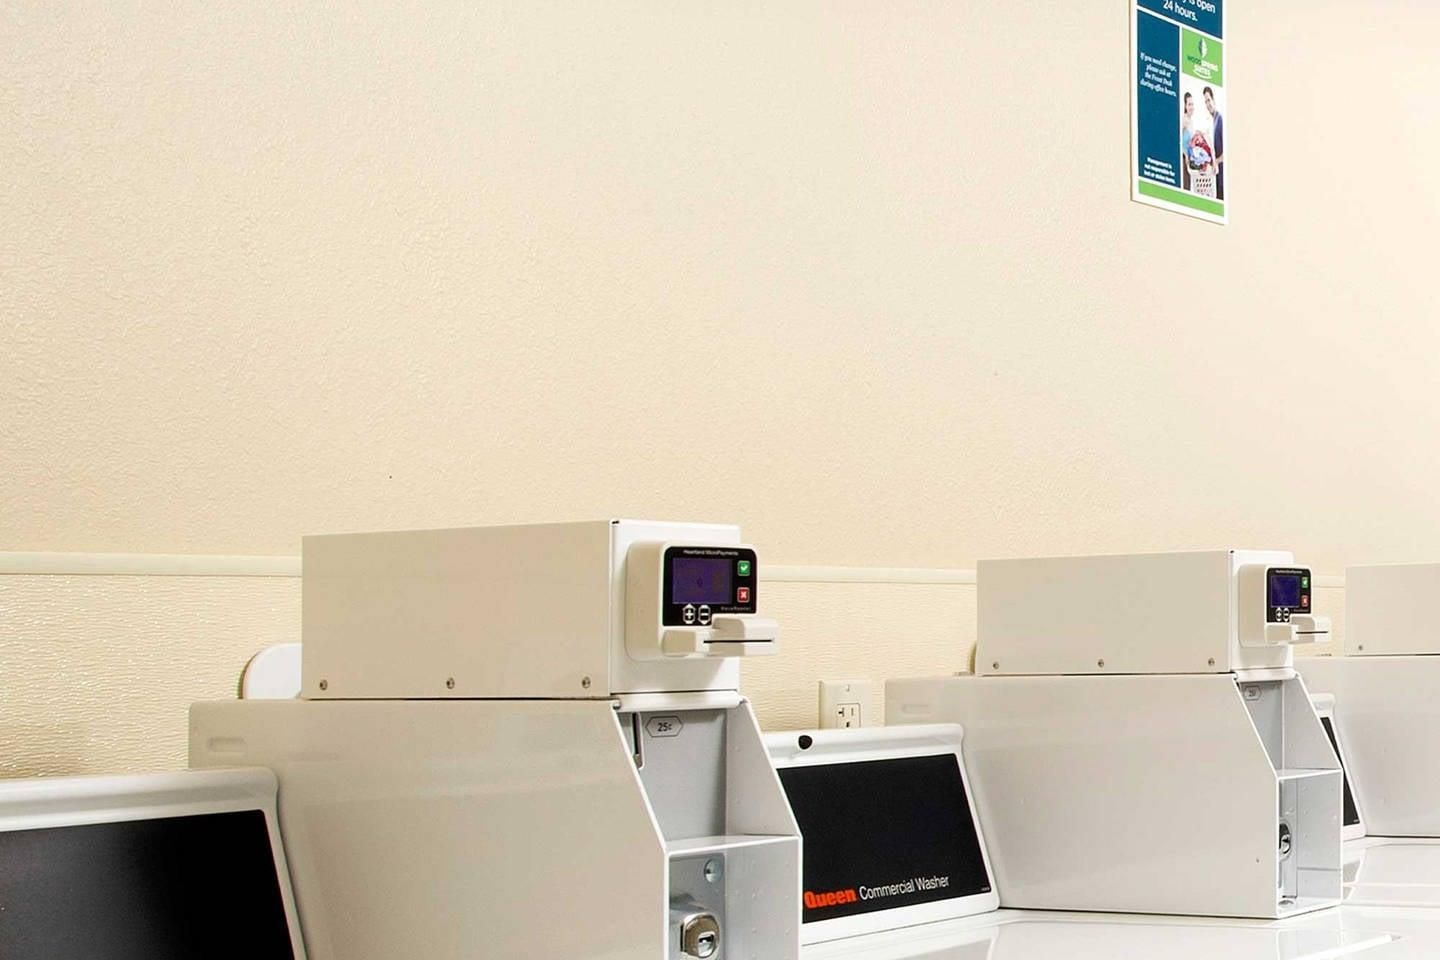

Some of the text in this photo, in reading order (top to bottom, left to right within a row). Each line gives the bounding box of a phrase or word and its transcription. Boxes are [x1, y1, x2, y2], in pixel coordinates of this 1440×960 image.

[1163, 0, 1198, 22] 24 hours.
[1197, 0, 1216, 14] open
[804, 875, 950, 909] Queen Commercial Washer
